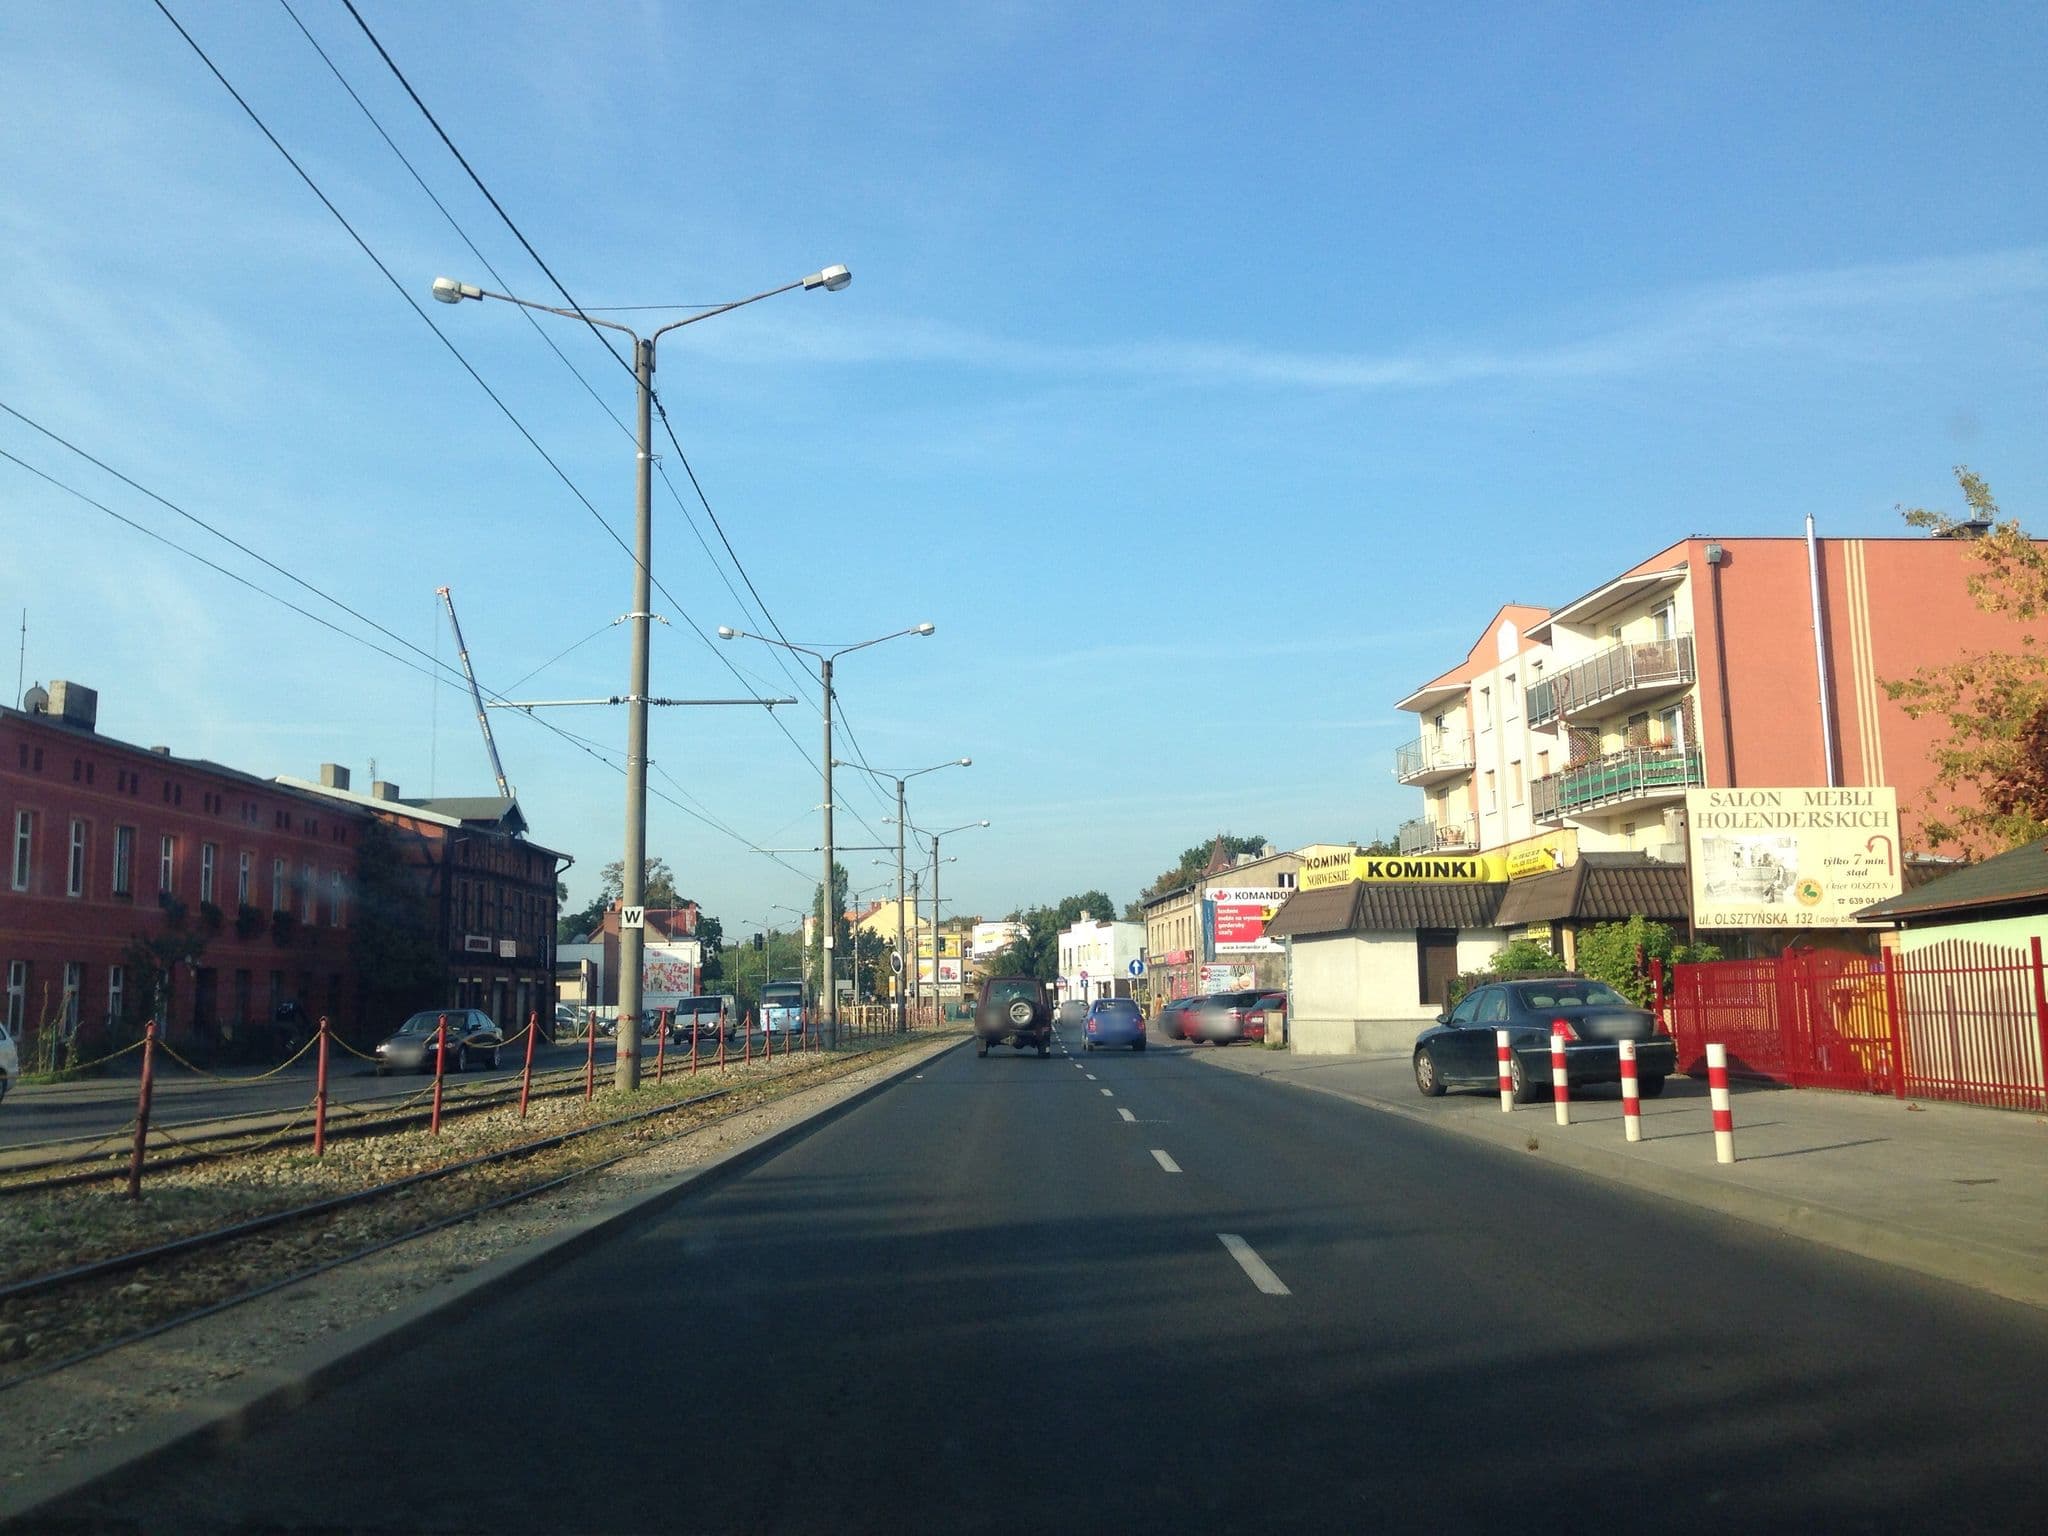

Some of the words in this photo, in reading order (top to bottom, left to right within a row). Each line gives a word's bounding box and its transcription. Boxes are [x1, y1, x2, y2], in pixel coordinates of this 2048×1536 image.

[1709, 791, 1782, 808] SALON
[1804, 790, 1873, 807] MEBLI
[1697, 811, 1889, 829] HOLENDERSKICH
[1306, 852, 1351, 871] KOMINKI
[1823, 857, 1850, 868] tylko
[1853, 853, 1862, 865] 7
[1306, 868, 1351, 886] NORWESKIE
[1367, 861, 1477, 878] KOMINKI
[1848, 897, 1864, 905] 639
[624, 910, 641, 924] W
[1698, 914, 1710, 925] ul.
[1714, 911, 1788, 925] OLSZTYŃSKA
[1796, 913, 1813, 924] 132
